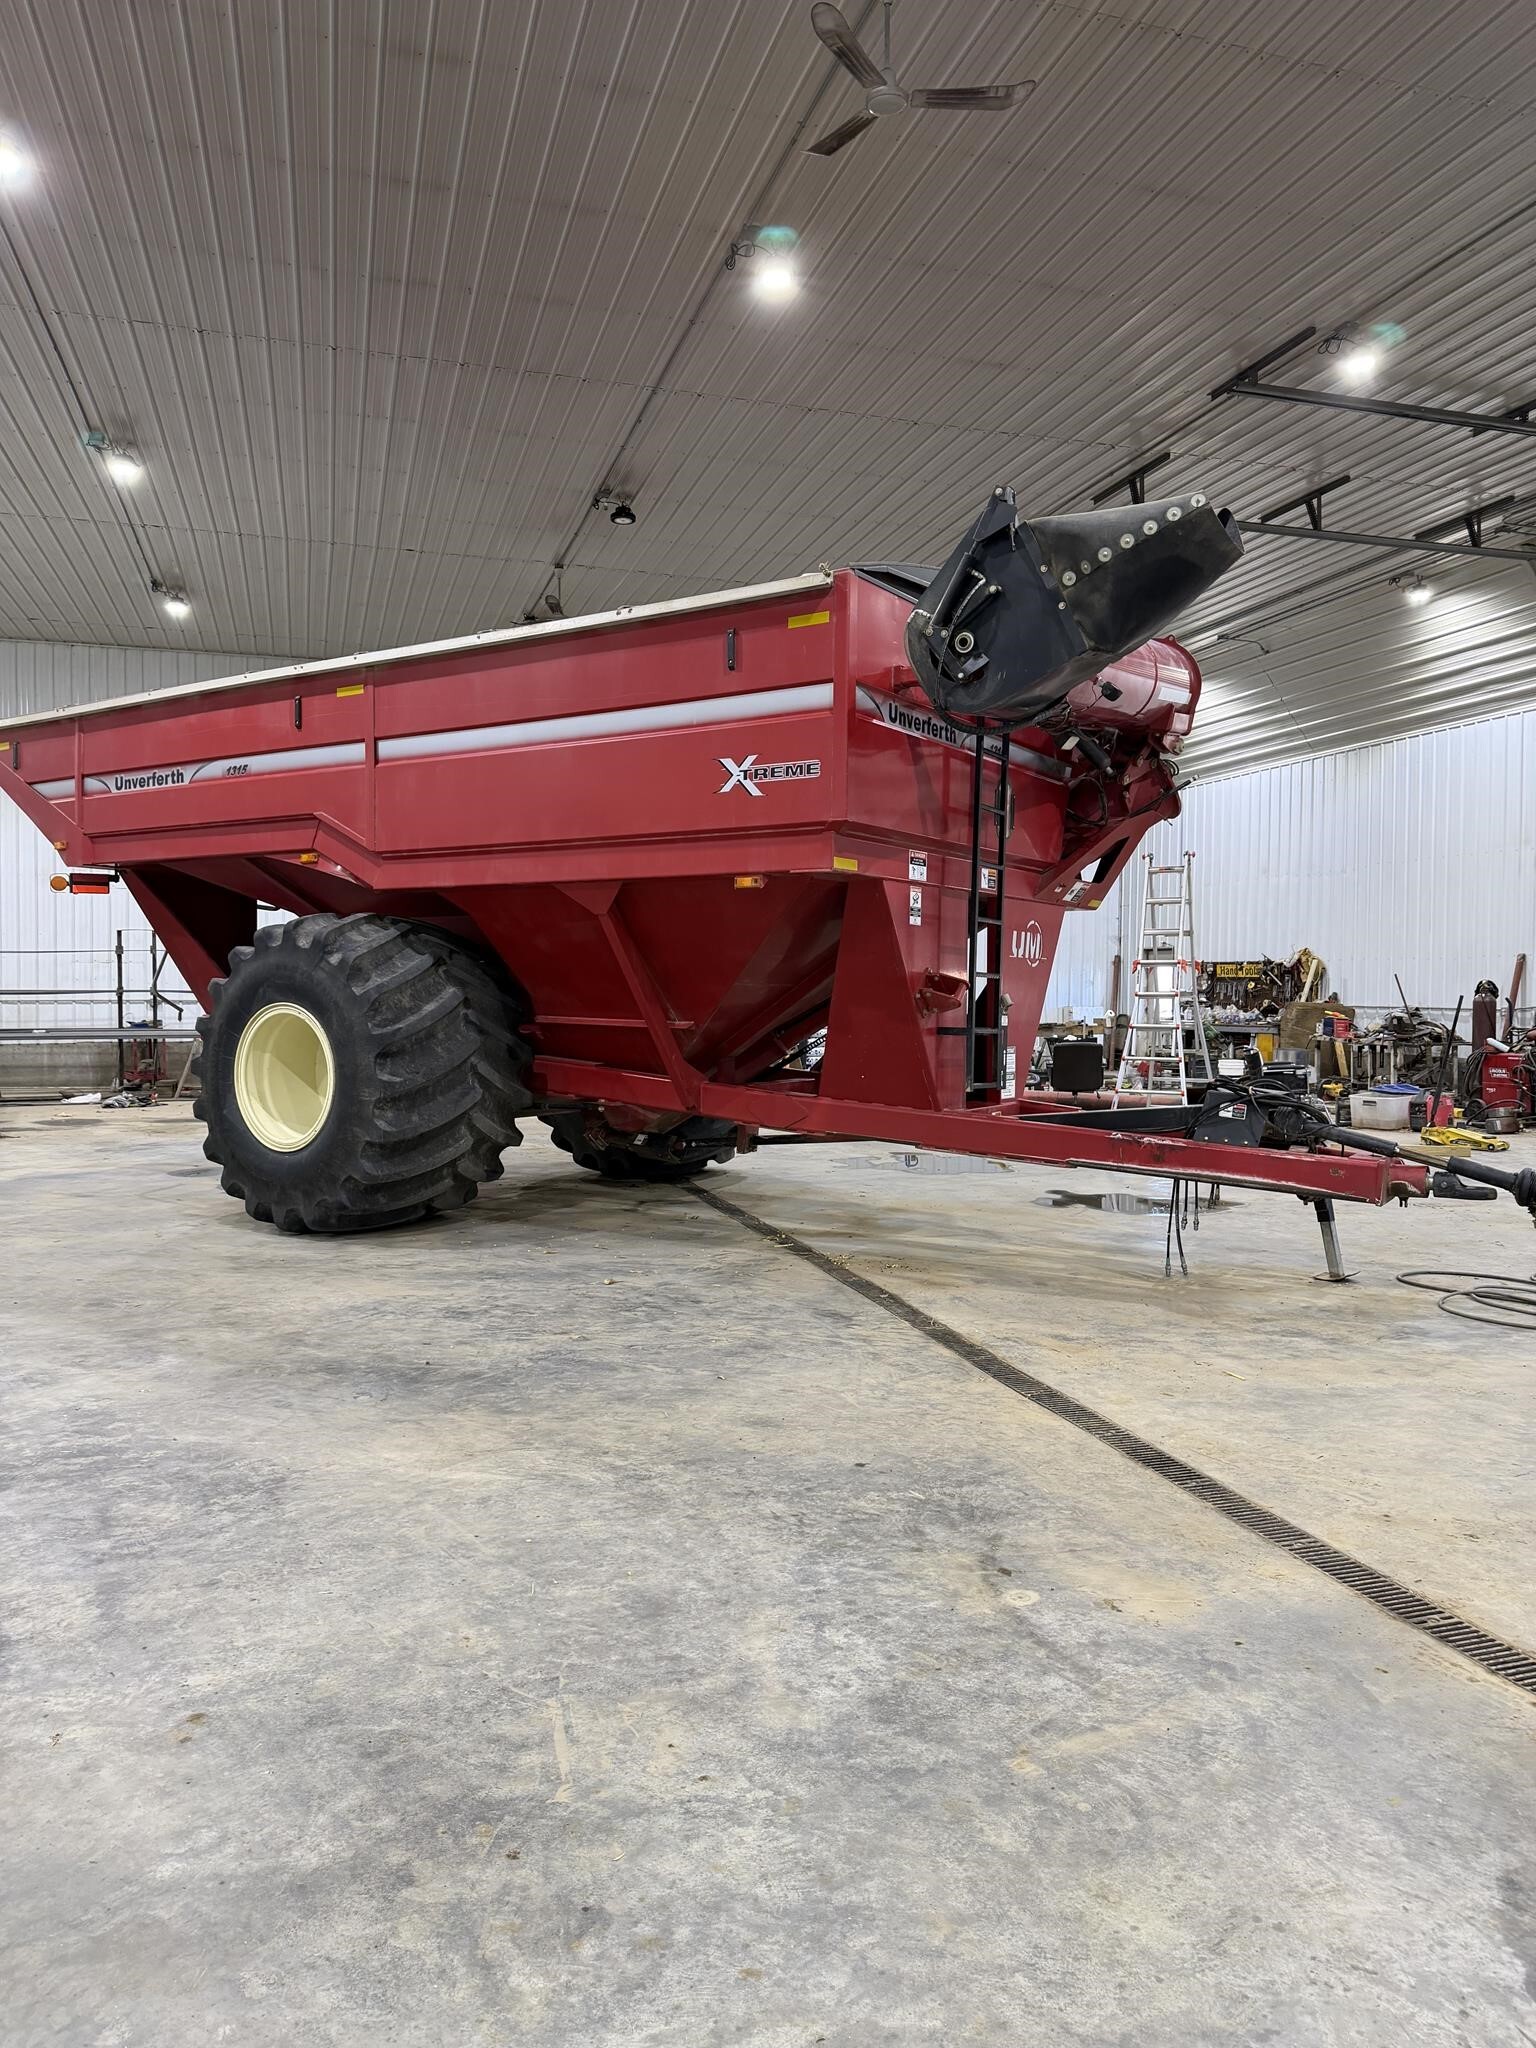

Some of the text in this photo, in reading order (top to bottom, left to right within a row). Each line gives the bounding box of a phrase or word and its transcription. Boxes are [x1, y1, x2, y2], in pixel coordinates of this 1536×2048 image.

[888, 702, 957, 744] Unverferth
[115, 764, 249, 791] Unverferth 1315
[713, 754, 821, 796] XTREME
[1220, 965, 1239, 976] Hand
